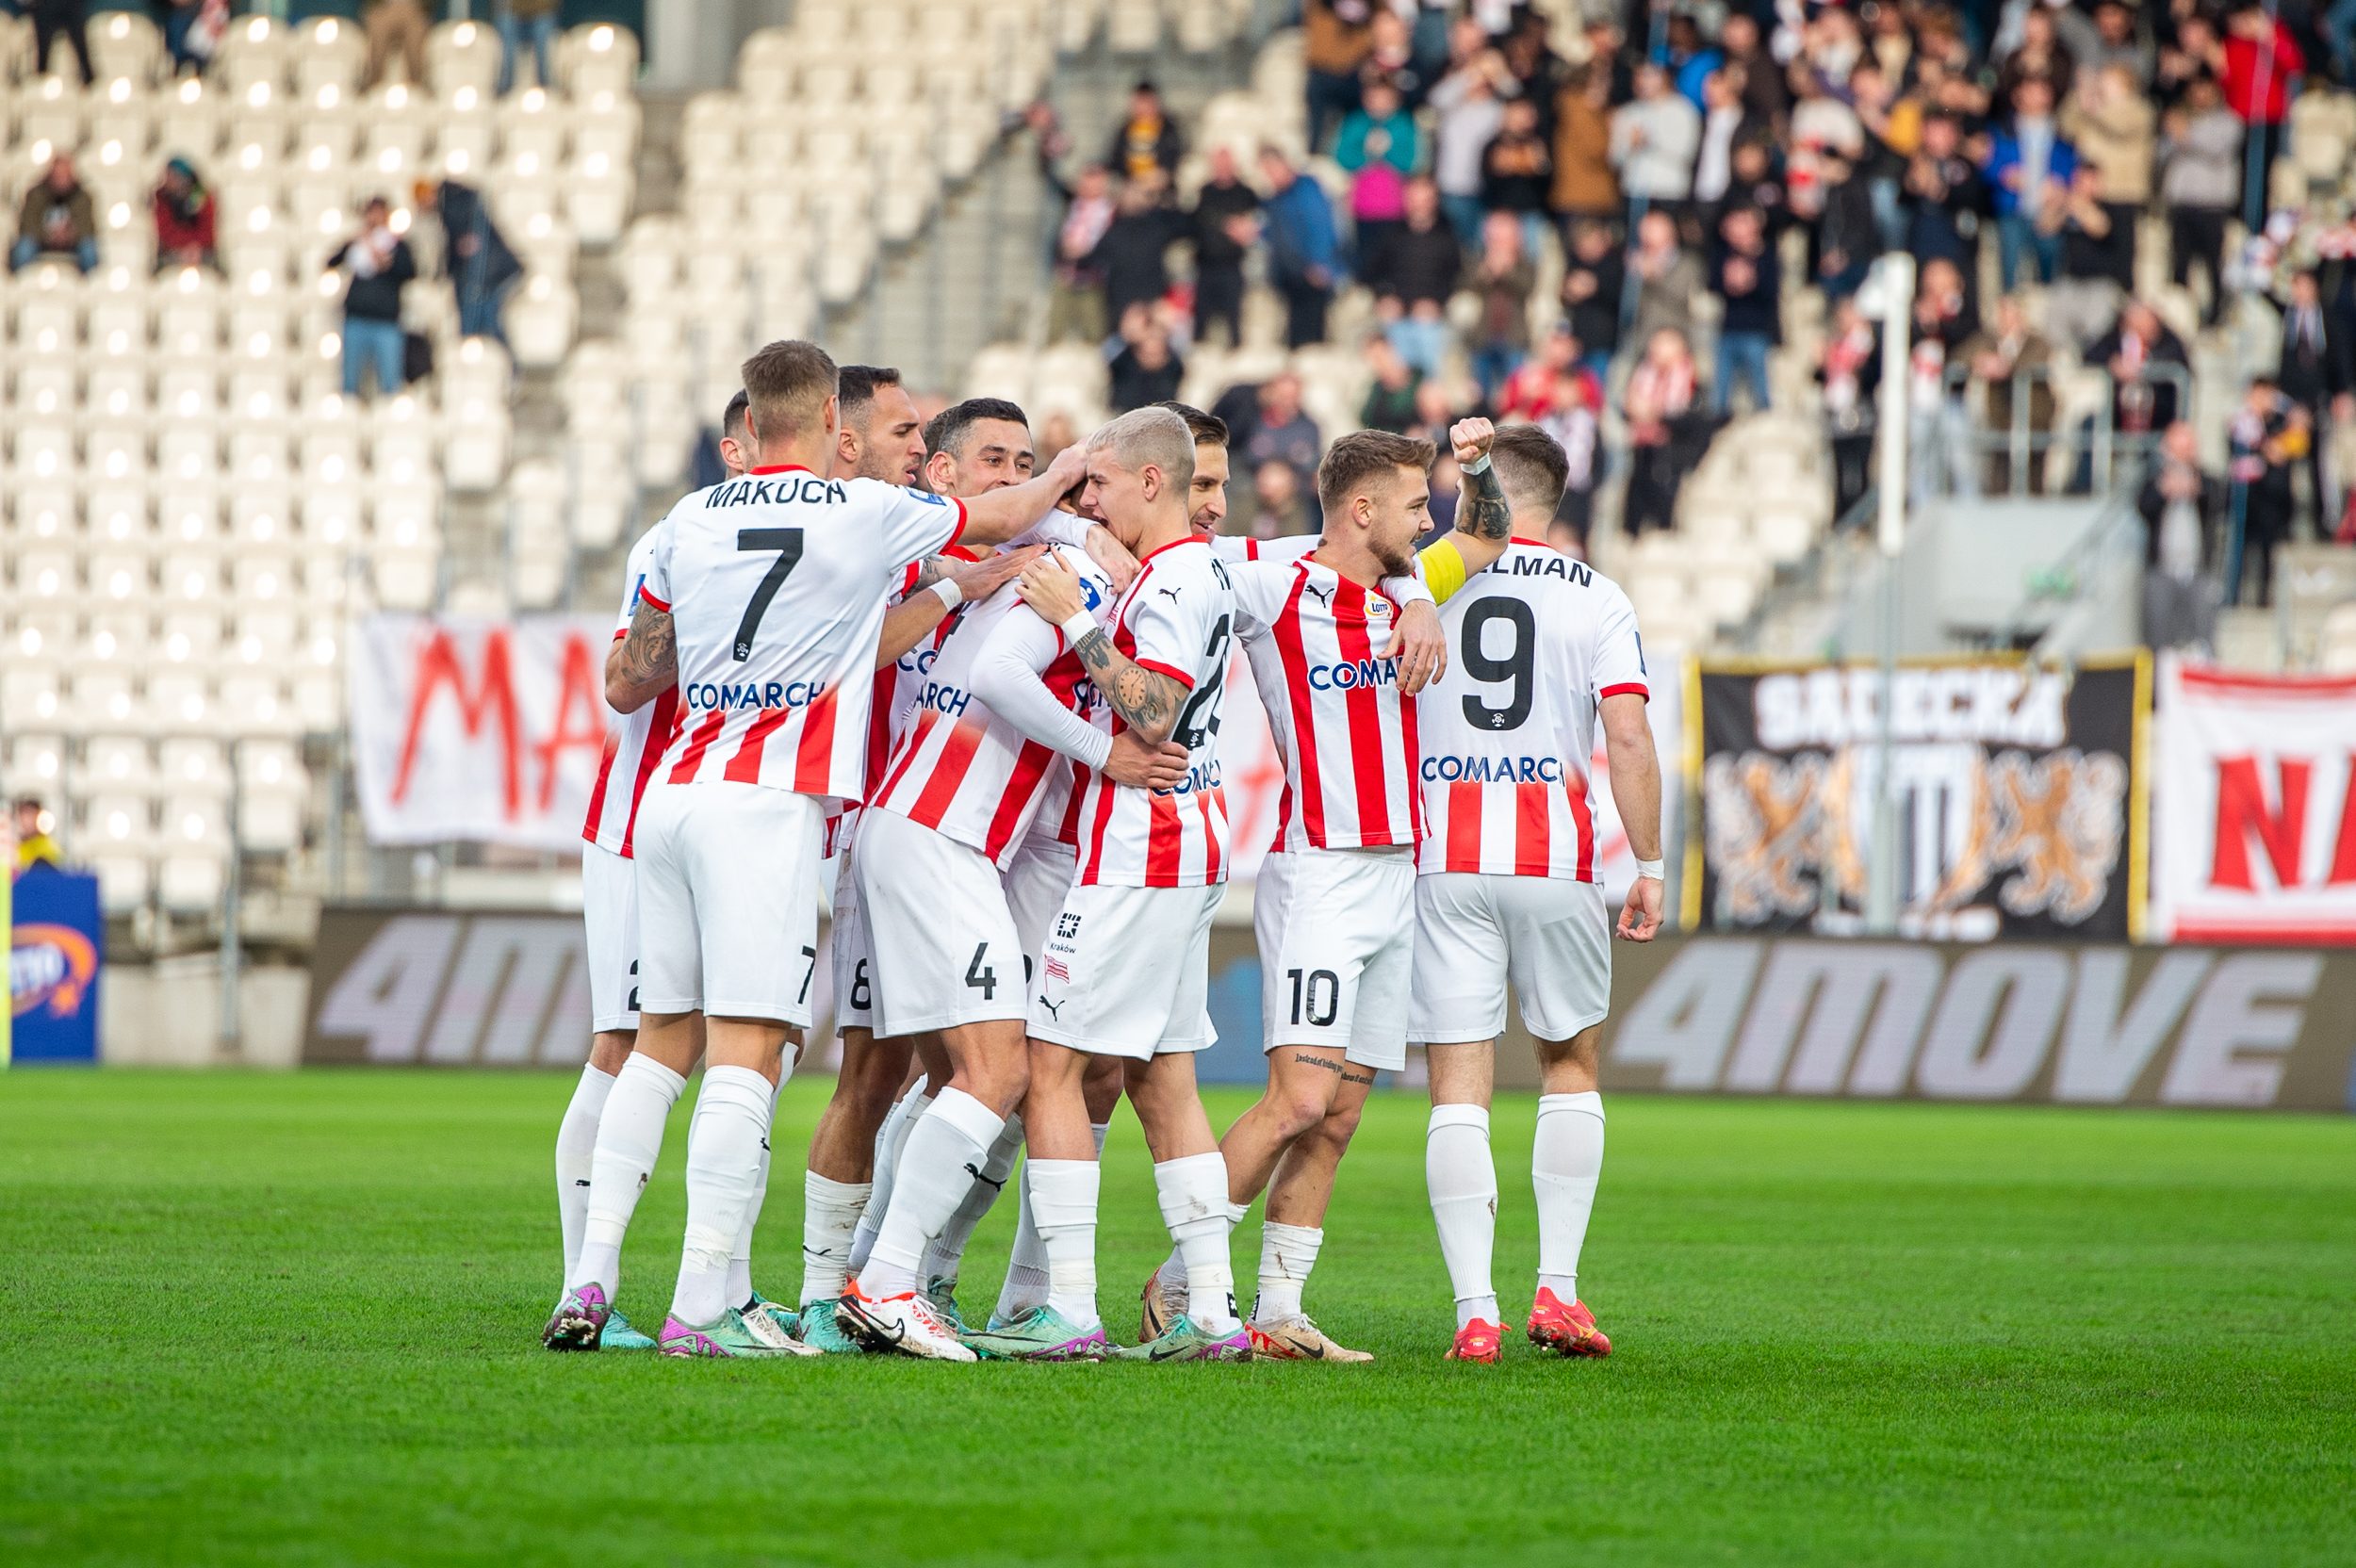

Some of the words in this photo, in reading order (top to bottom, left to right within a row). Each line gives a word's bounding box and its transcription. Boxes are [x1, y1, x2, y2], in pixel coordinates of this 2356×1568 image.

[705, 478, 847, 509] MAKUCH
[732, 528, 804, 662] 7
[1480, 555, 1593, 588] LMAN
[1371, 602, 1389, 613] LOTTO
[1309, 656, 1417, 691] COMA
[1461, 596, 1535, 731] 9
[1420, 755, 1566, 788] COMARC
[965, 941, 997, 1001] 4
[1050, 942, 1076, 954] Kraków
[798, 944, 817, 1005] 7
[1287, 968, 1340, 1027] 10
[1611, 940, 2326, 1106] 4MOVE
